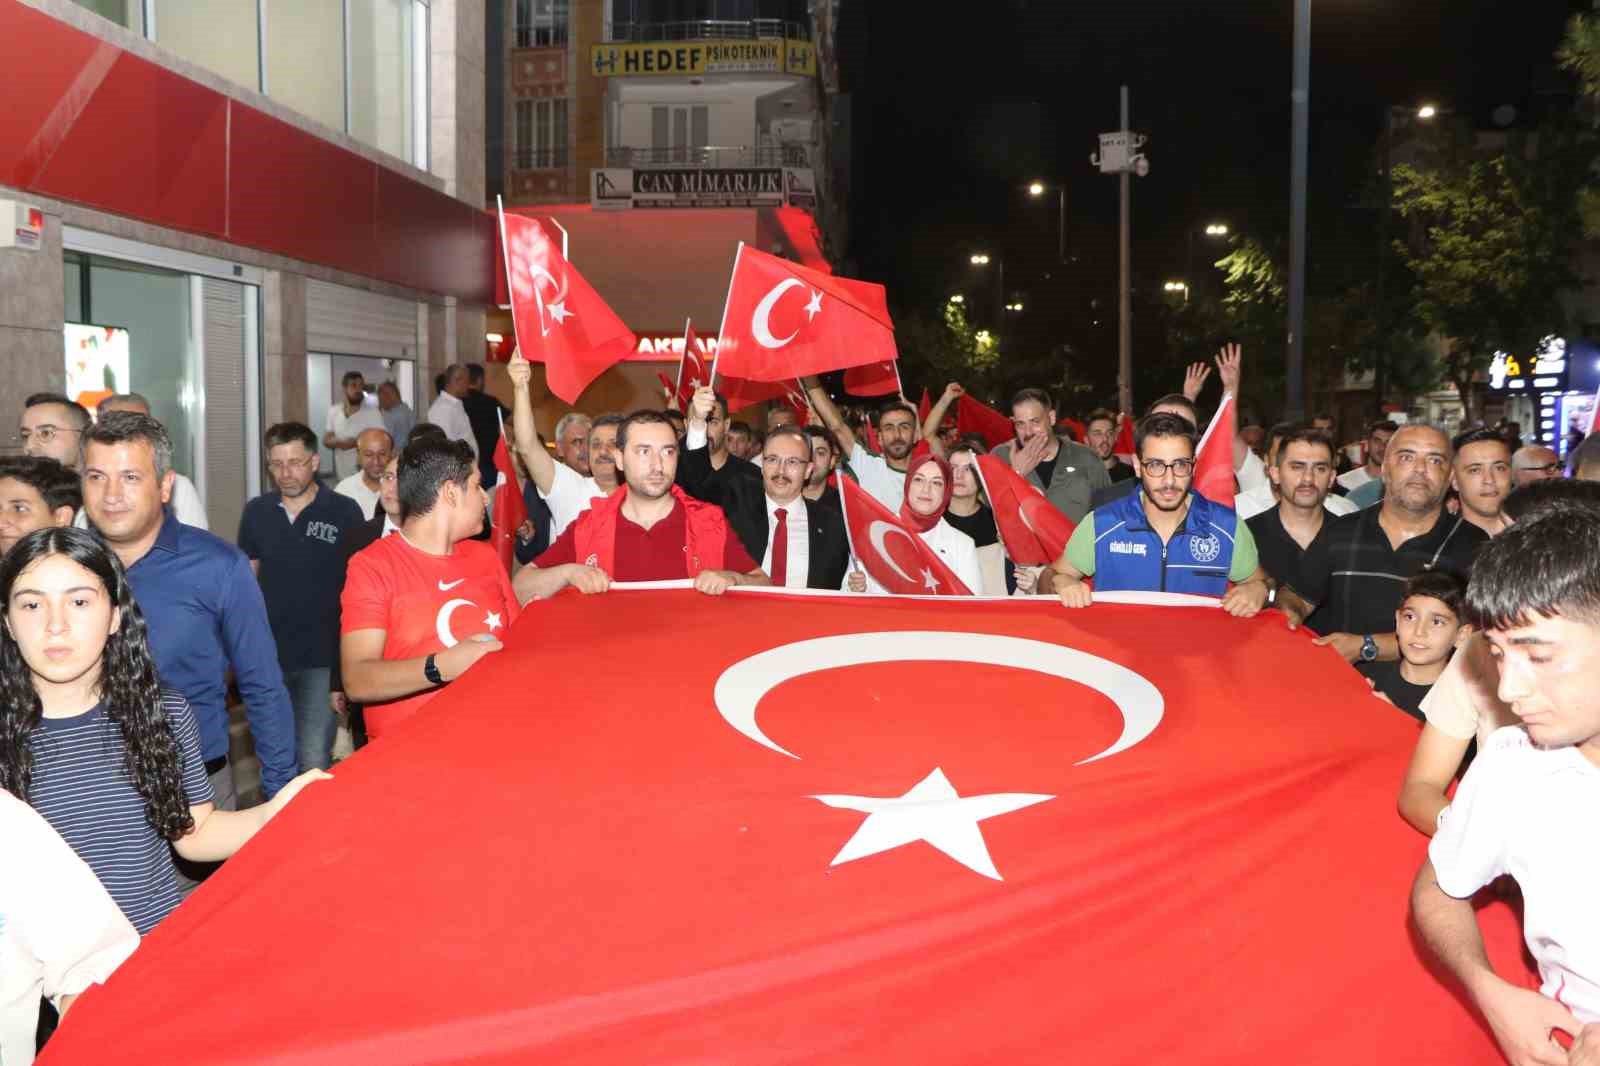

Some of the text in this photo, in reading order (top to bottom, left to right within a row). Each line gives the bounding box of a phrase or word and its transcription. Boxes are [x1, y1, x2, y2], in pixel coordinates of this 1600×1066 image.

[624, 49, 701, 72] HEDEF
[638, 168, 779, 193] CAN MİMARLIK
